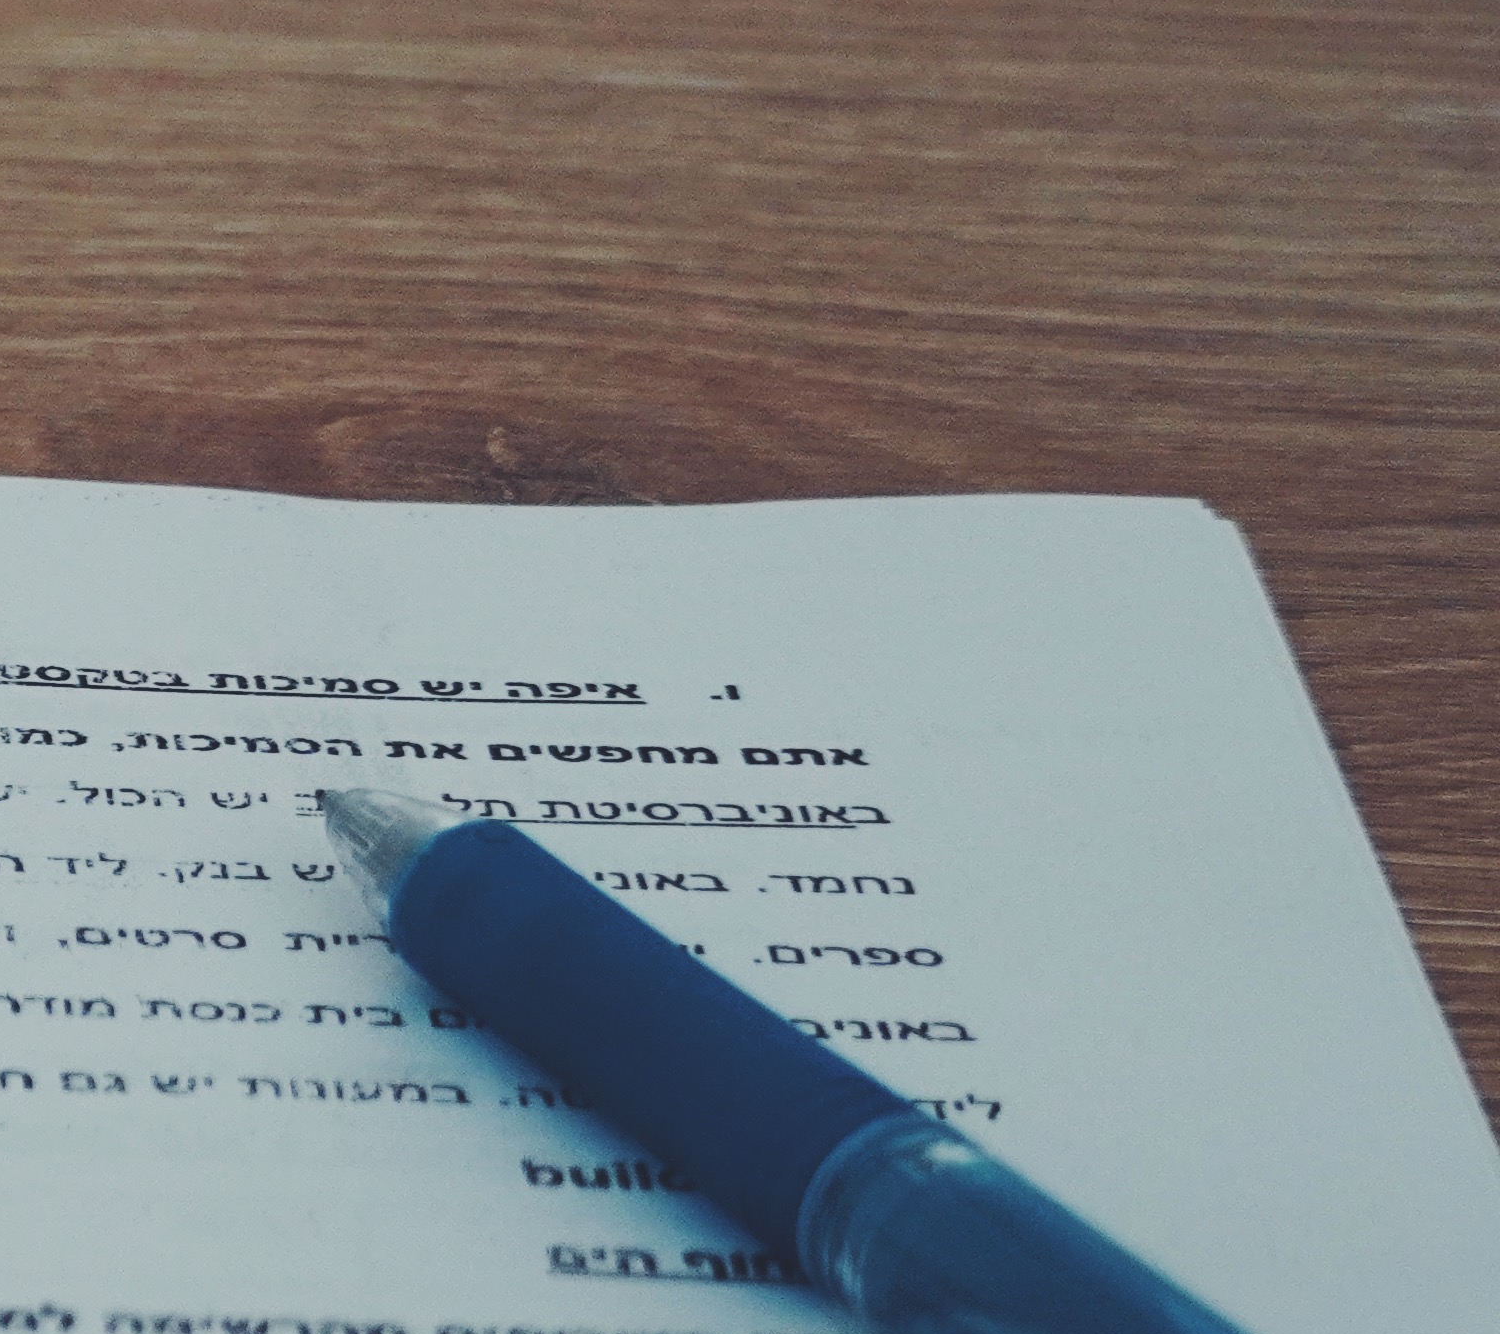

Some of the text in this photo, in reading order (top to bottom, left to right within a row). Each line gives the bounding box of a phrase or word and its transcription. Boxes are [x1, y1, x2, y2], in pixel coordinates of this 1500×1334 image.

[208, 671, 401, 696] סמיכות
[424, 678, 486, 698] יש
[508, 680, 646, 700] איפה
[0, 727, 89, 748] כמו
[111, 732, 363, 758] הסמיכות,
[384, 740, 467, 761] את
[487, 743, 720, 766] מחפשים
[740, 746, 869, 767] אתם
[57, 779, 187, 808] הכול.
[540, 800, 890, 825] באוניברסיטת
[53, 851, 128, 877] ליד
[160, 860, 272, 885] בנק.
[593, 871, 729, 893] באוני
[758, 874, 917, 896] נחמד.
[57, 925, 248, 951] סרטים,
[283, 929, 396, 954] ריית
[753, 943, 943, 966] ספרים.
[145, 998, 283, 1024] כנסת
[303, 1000, 404, 1029] בית
[791, 1018, 977, 1042] באוניב
[241, 1071, 479, 1108] במעונות
